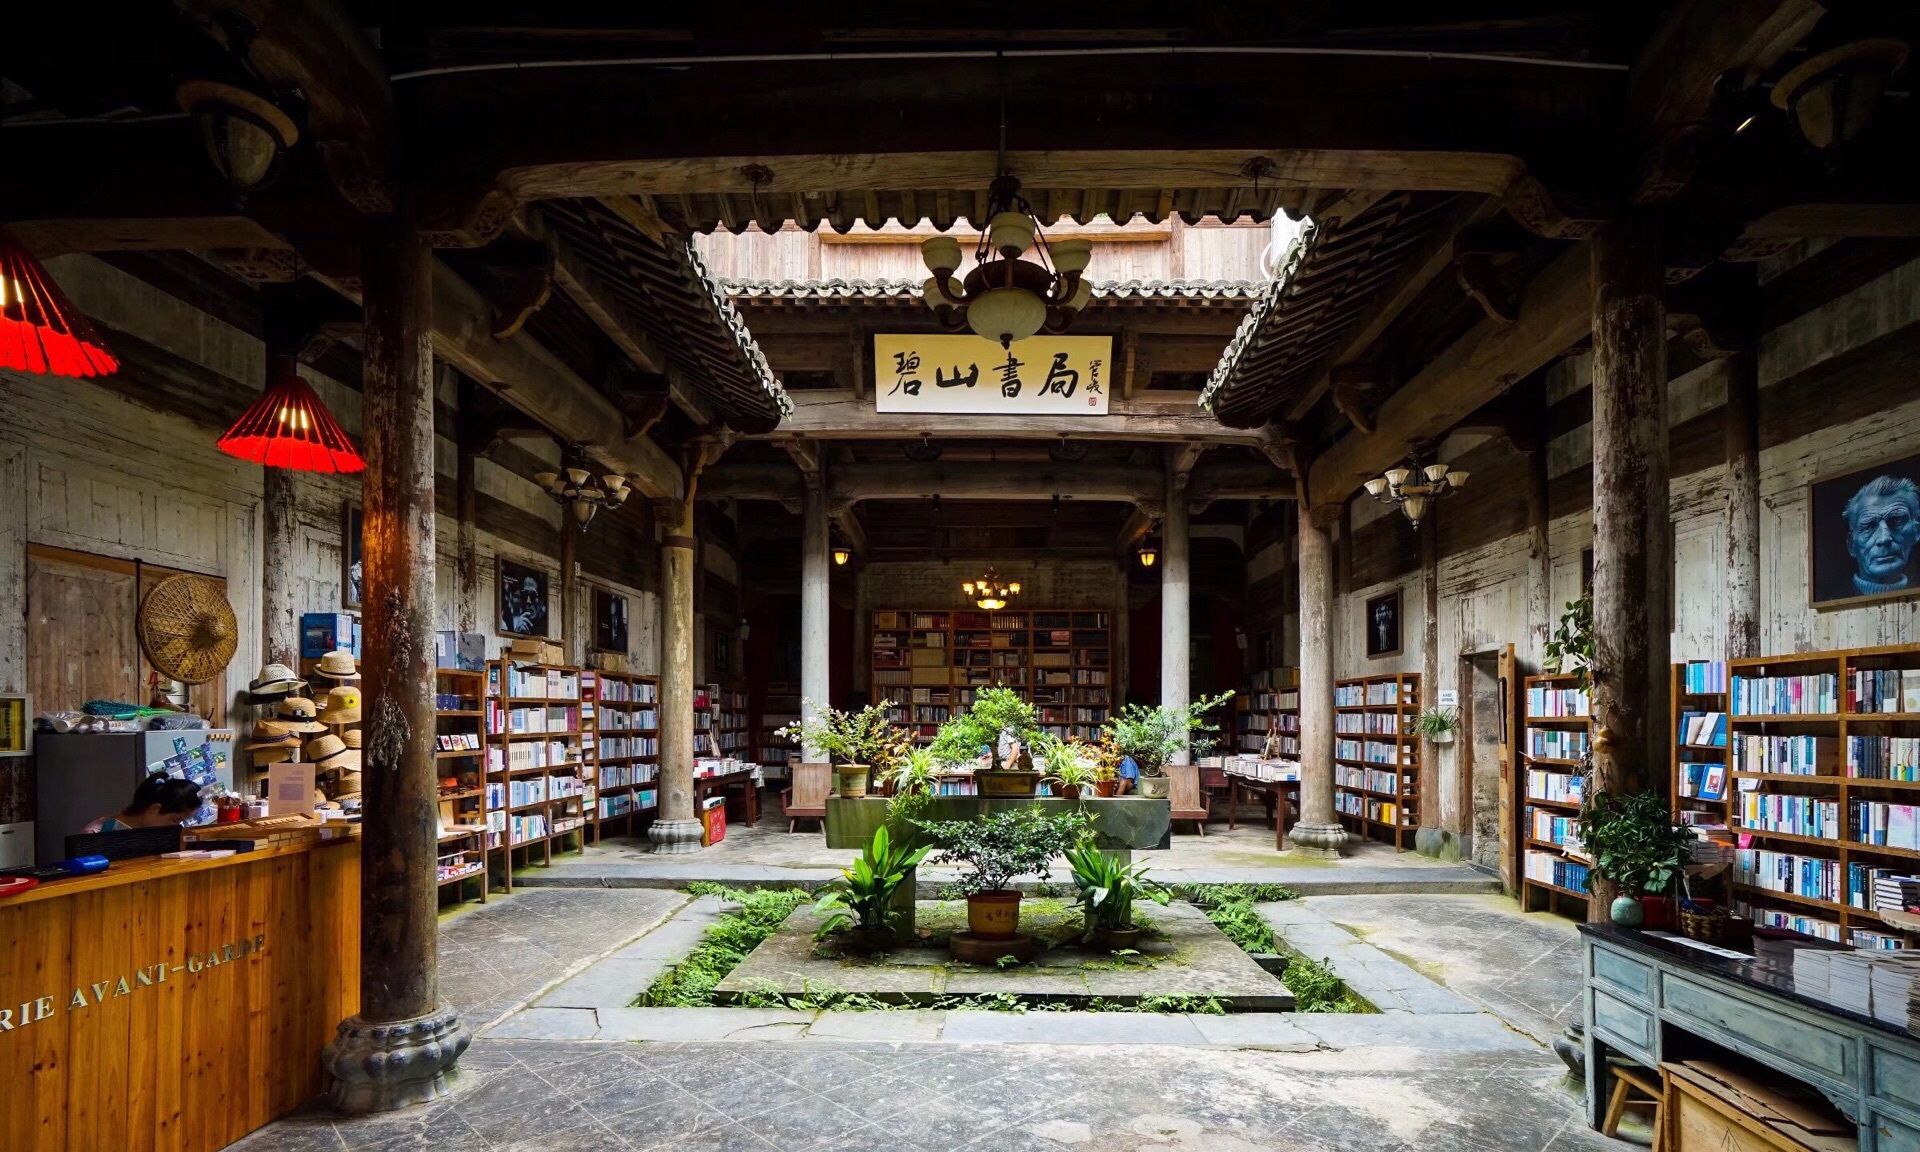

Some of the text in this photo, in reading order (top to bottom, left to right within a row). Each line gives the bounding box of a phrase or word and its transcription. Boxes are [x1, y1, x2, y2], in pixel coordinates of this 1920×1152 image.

[888, 350, 1079, 399] 碧山書局
[68, 933, 266, 1011] AVANT-GARDE
